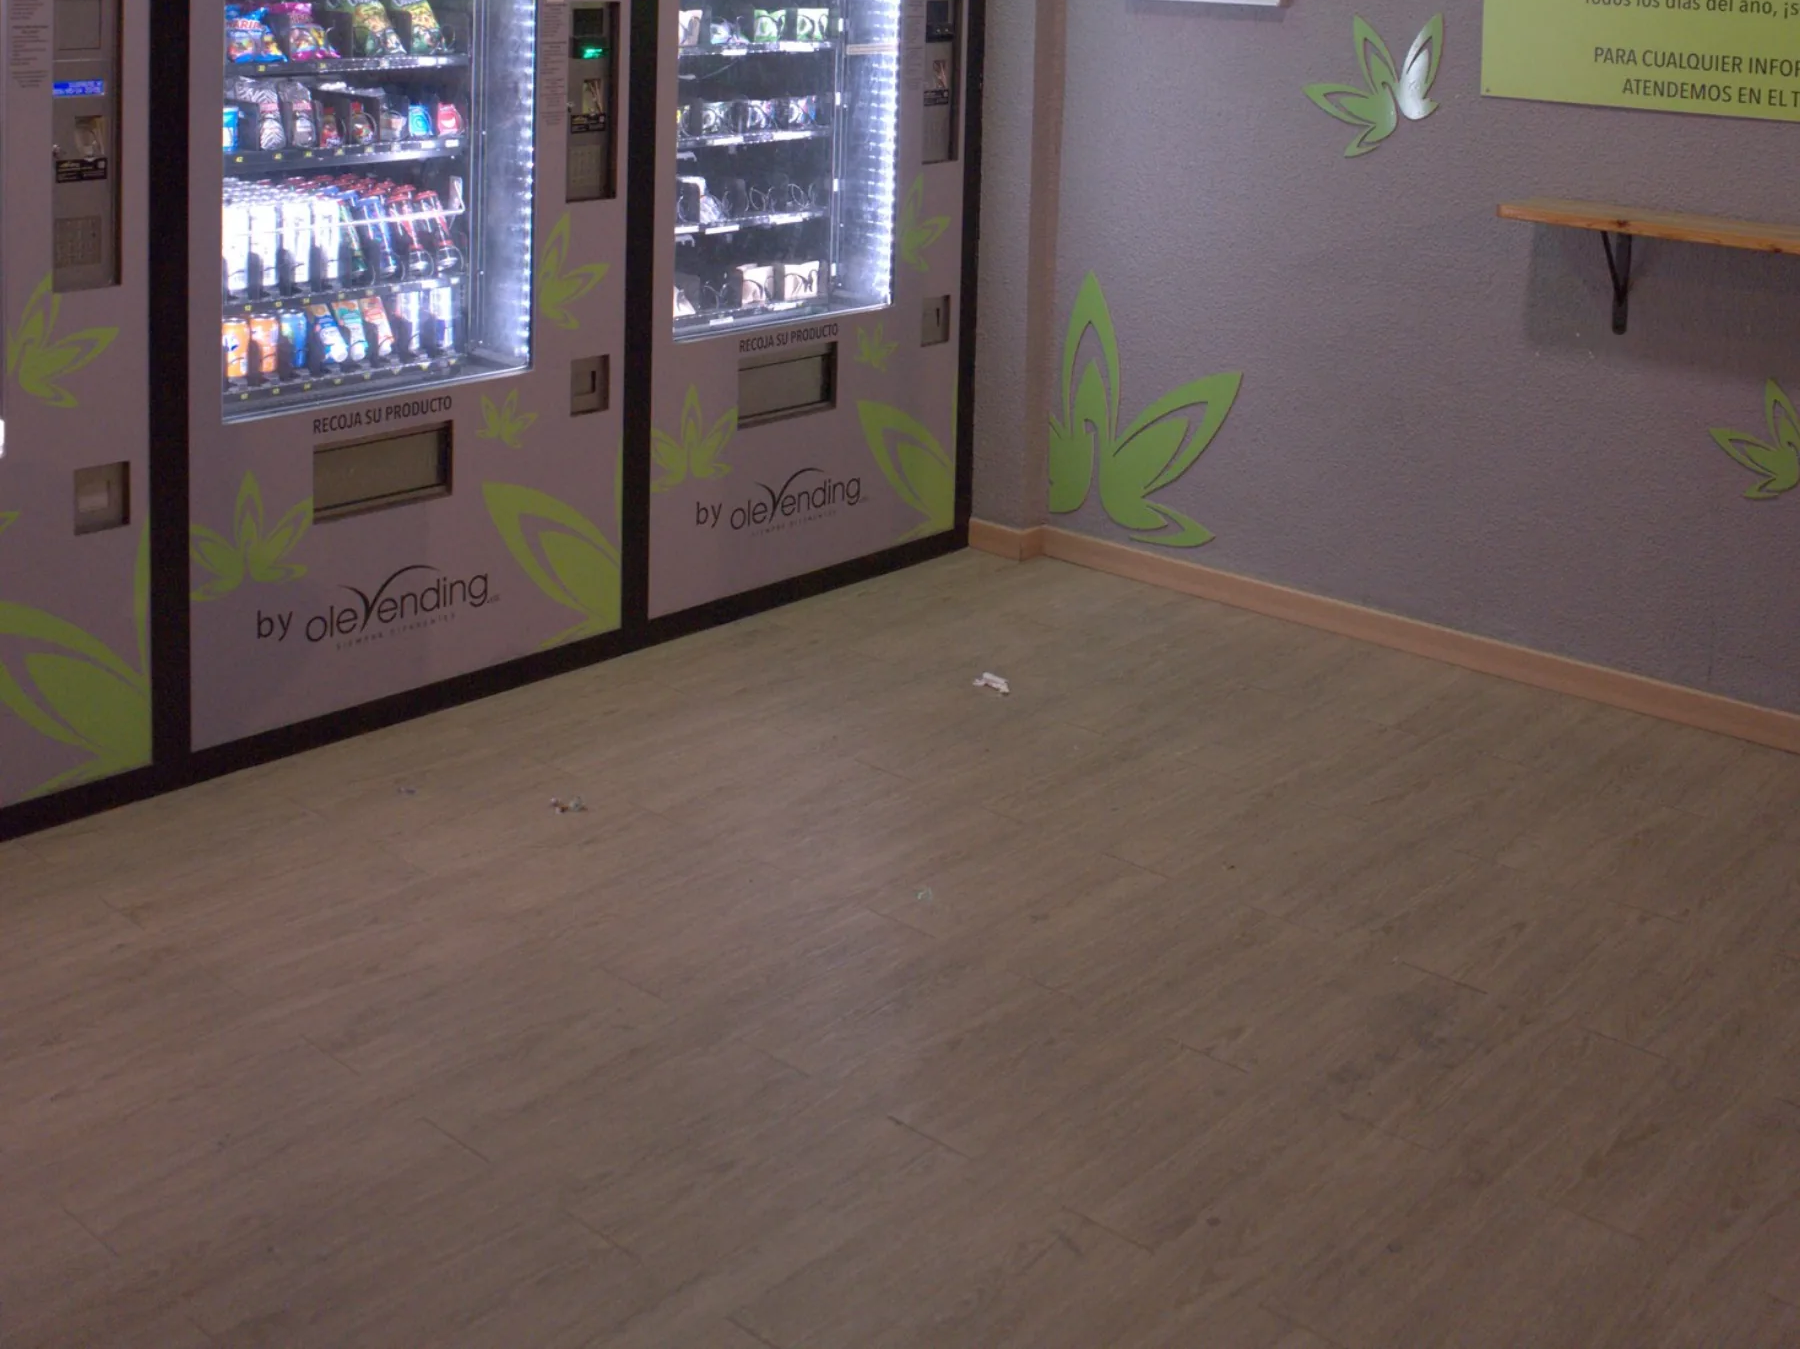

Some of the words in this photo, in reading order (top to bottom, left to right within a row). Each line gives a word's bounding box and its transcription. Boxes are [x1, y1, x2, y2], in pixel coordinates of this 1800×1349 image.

[1594, 46, 1638, 66] PARA
[1642, 49, 1743, 74] CUALQUIER
[1622, 78, 1732, 103] ATENDEMOS
[1738, 87, 1761, 105] EN
[1768, 89, 1787, 107] EL
[739, 335, 774, 353] RECOJA
[776, 333, 789, 345] SU
[791, 323, 838, 344] PRODUCTO
[313, 412, 362, 434] RECOJA
[366, 407, 383, 425] SU
[386, 396, 452, 421] PRODUCTO
[696, 502, 722, 528] by
[257, 610, 293, 641] by
